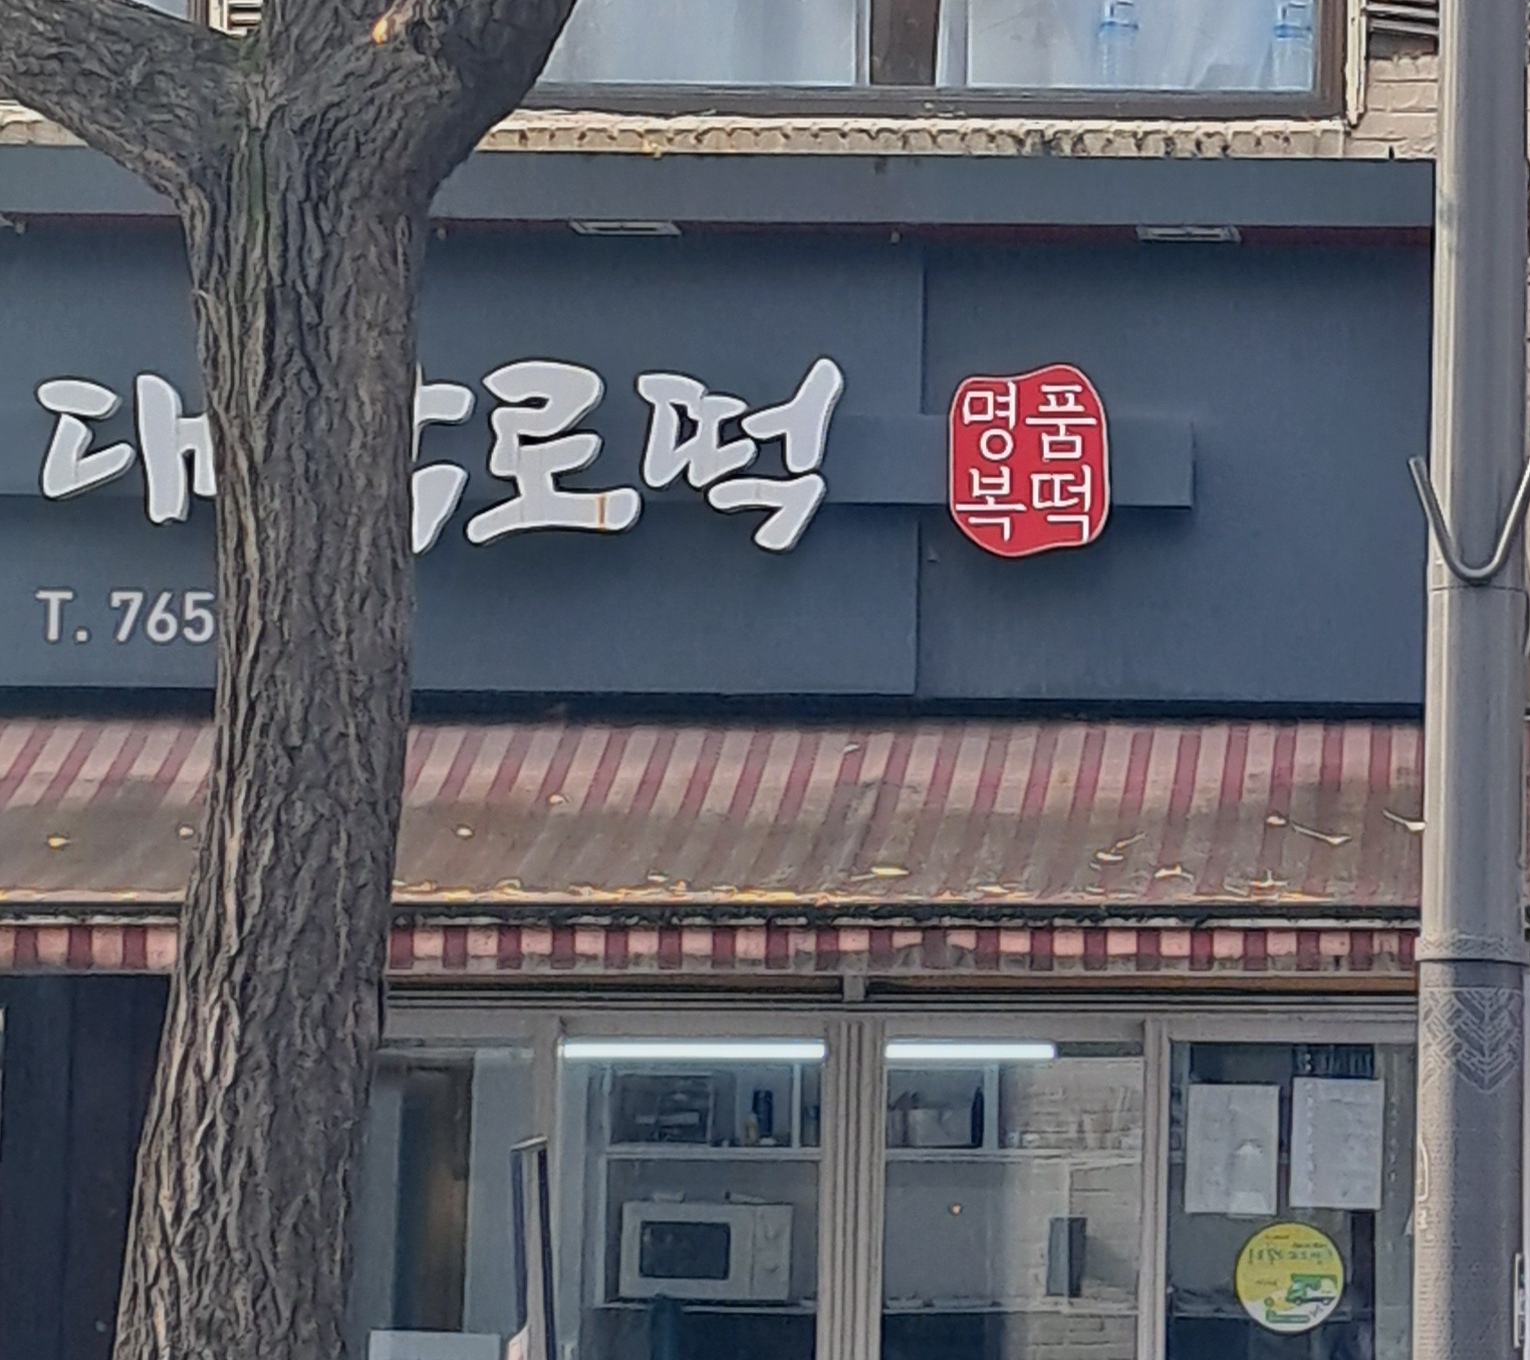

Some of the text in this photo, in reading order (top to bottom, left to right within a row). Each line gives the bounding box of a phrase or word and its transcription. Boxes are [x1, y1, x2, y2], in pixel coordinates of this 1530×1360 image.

[37, 357, 842, 556] 대로떡
[963, 381, 1096, 462] 명품
[956, 465, 1092, 543] 복떡
[36, 589, 90, 641] T.
